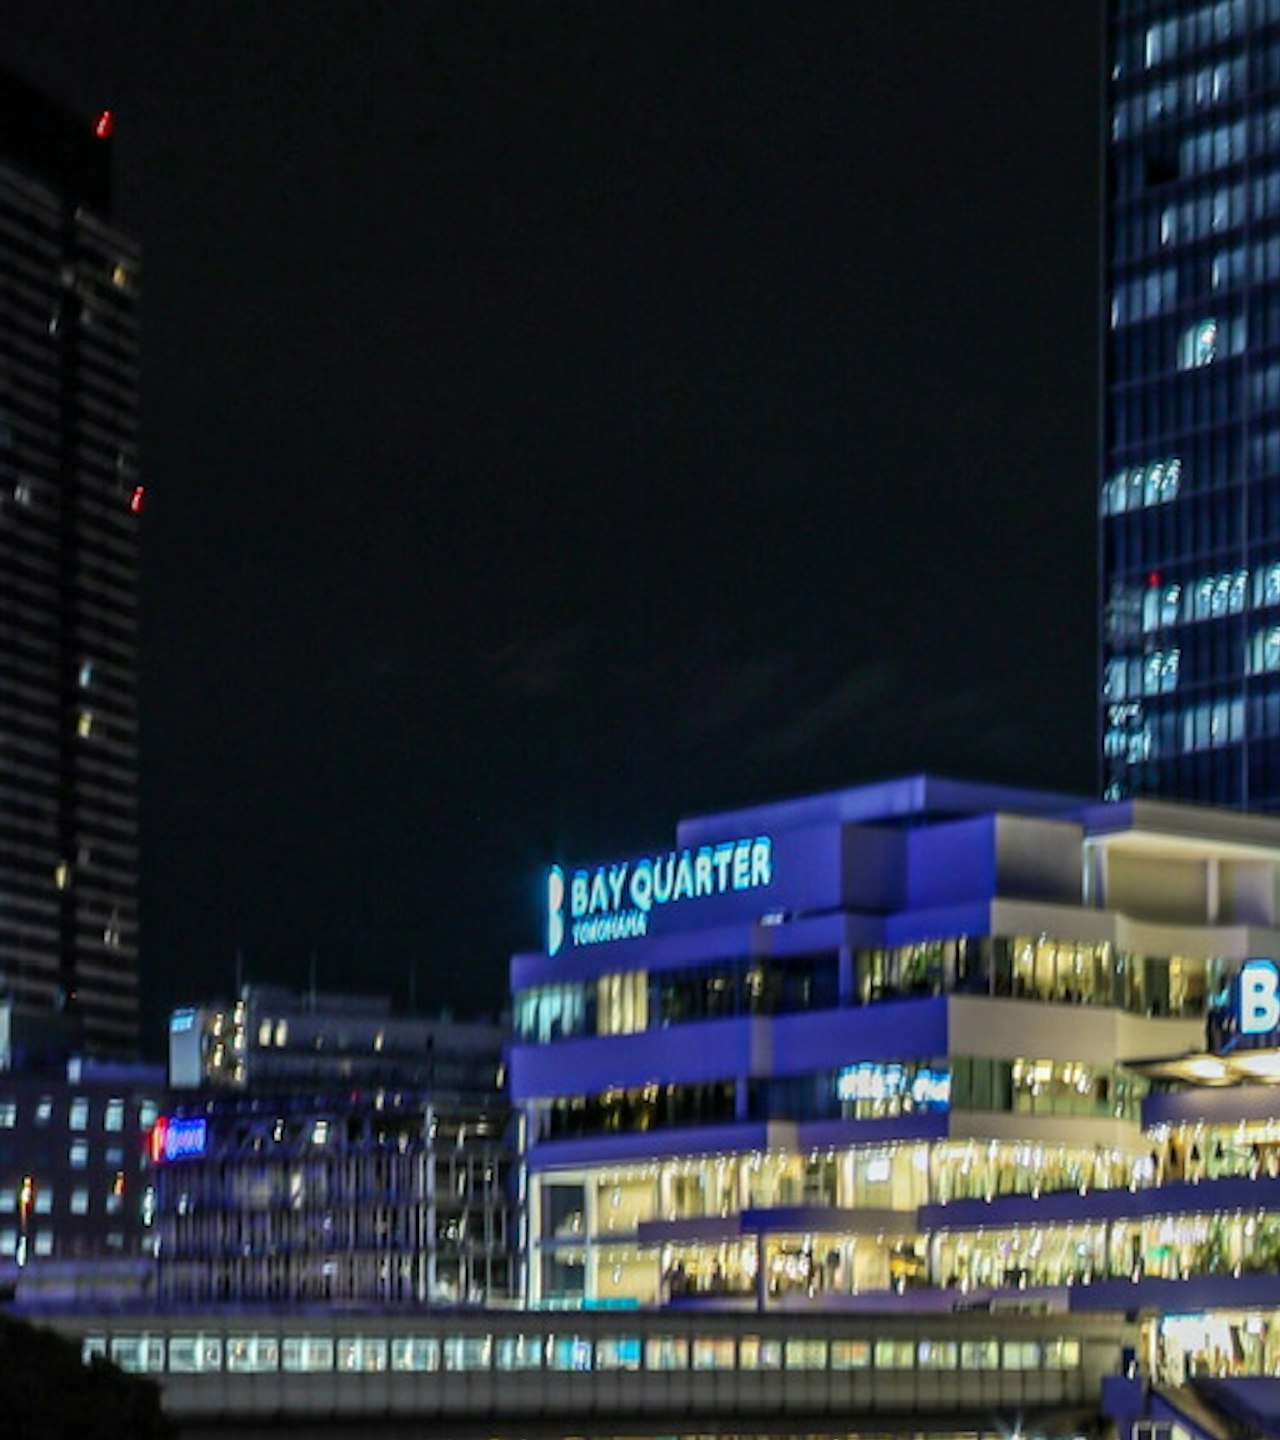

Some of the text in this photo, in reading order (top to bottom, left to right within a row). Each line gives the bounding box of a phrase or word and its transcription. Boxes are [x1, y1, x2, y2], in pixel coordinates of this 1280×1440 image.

[571, 836, 772, 918] BAY QUARTER
[572, 910, 648, 947] YOKOHAMA
